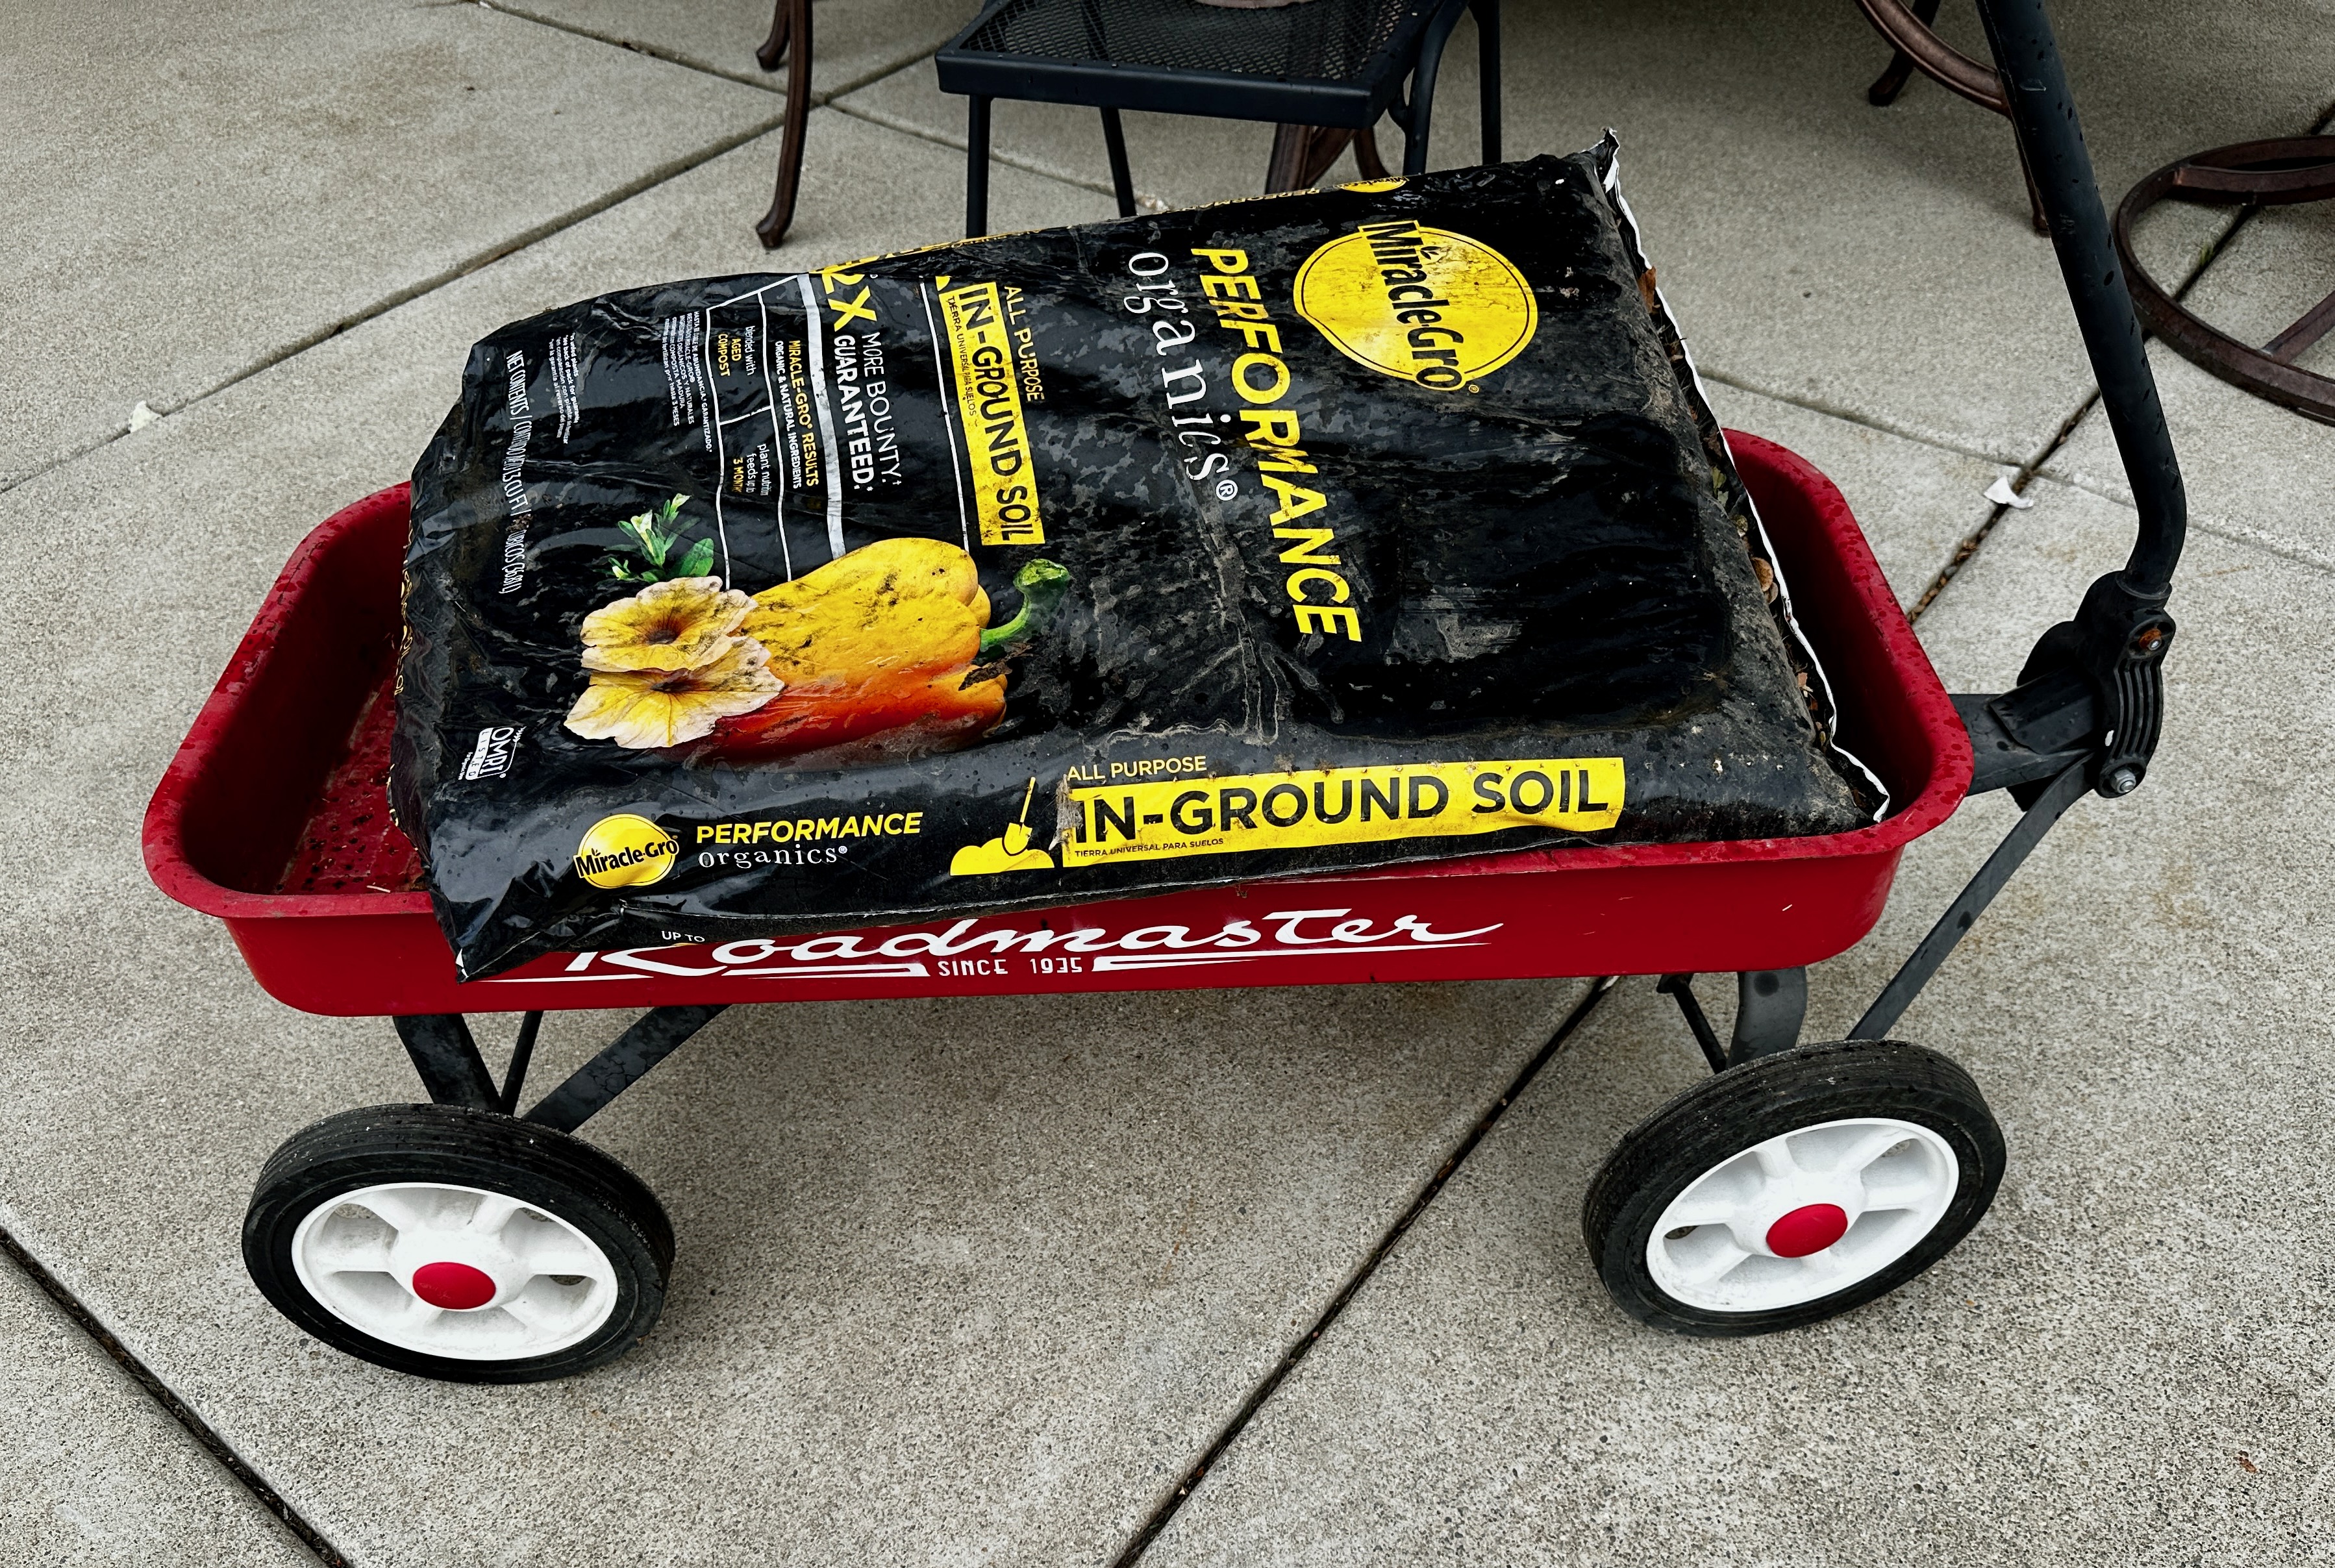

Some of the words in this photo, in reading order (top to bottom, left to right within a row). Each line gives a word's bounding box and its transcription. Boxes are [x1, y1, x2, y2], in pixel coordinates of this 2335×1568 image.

[1005, 286, 1026, 325] ALL
[718, 334, 730, 377] COMPOST
[731, 338, 742, 361] AGED
[745, 325, 755, 353] blended
[775, 340, 786, 375] ORGANIC
[862, 332, 884, 377] MORE
[947, 295, 962, 331] TIERRA
[957, 334, 969, 372] UNIVERSAL
[965, 386, 977, 416] SUELOS
[506, 350, 525, 372] NET
[669, 344, 680, 379] COMPOSTA
[675, 379, 686, 409] MADURA
[745, 354, 756, 376] with
[1014, 328, 1045, 401] PURPOSE
[508, 369, 529, 416] CONTENTS
[677, 342, 688, 380] ORGÁNICOS
[684, 386, 695, 424] NATURALES
[780, 384, 795, 432] NATURAL
[958, 288, 1022, 477] IN-GROUND
[996, 486, 1034, 541] SOIL
[757, 443, 771, 470] plant
[788, 432, 802, 489] INGREDIENTS
[802, 432, 819, 486] RESULTS
[1190, 248, 1362, 642] PERFORMANCE
[746, 453, 758, 479] feeds
[505, 480, 523, 497] CU
[509, 494, 528, 510] FT
[469, 731, 490, 777] LISTED
[479, 727, 514, 774] OMRI
[1067, 764, 1105, 781] ALL
[1110, 755, 1207, 778] PURPOSE
[1075, 775, 1449, 843] IN-GROUND
[1471, 769, 1609, 815] SOIL
[697, 812, 923, 844] PERFORMANCE
[1075, 849, 1108, 858] TIERRA
[1110, 844, 1160, 855] UNIVERSAL
[1163, 842, 1188, 851] PARA
[1190, 838, 1224, 847] SUELOS
[662, 930, 681, 940] UP
[684, 934, 705, 942] TO
[938, 959, 1008, 977] SINCE
[1030, 957, 1082, 974] 1935
